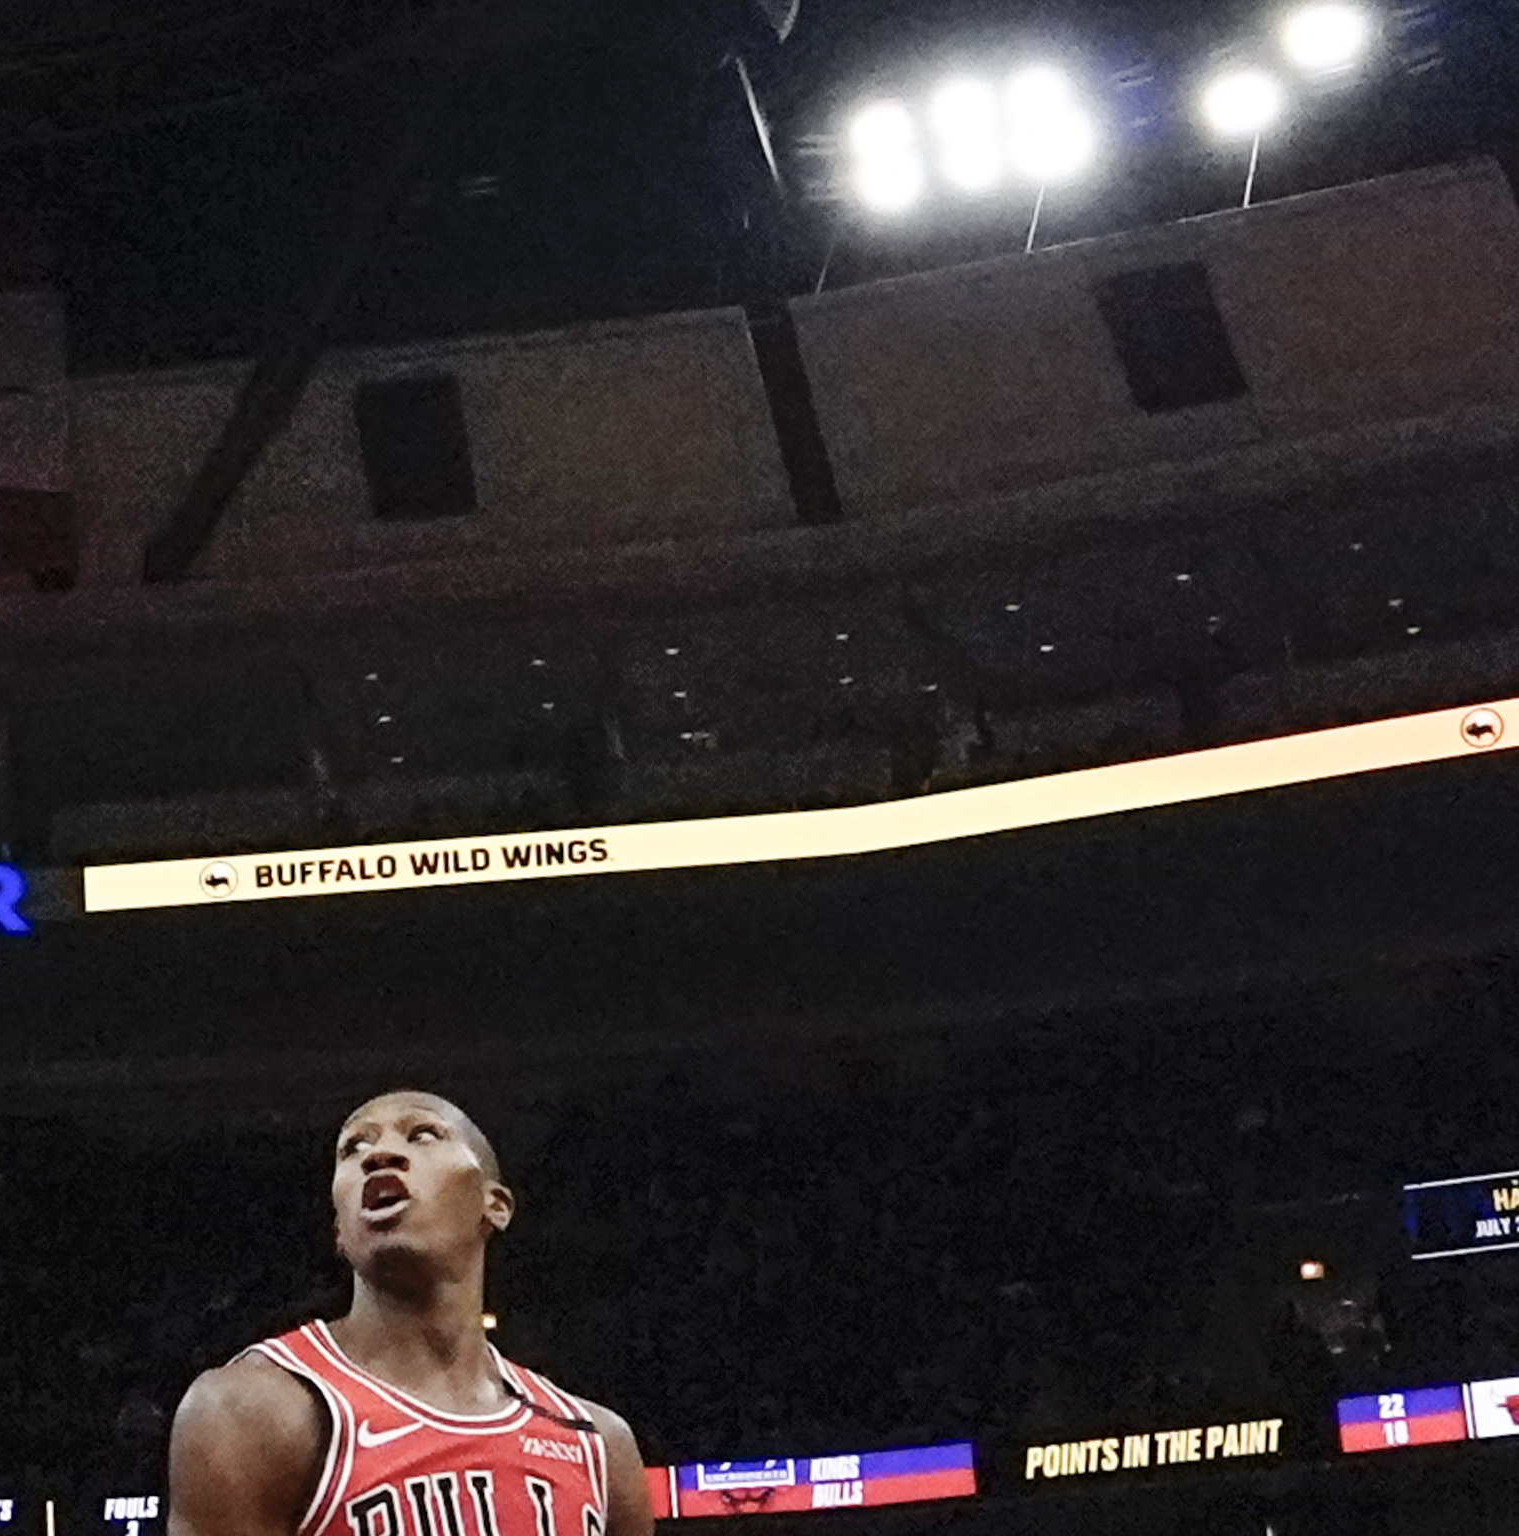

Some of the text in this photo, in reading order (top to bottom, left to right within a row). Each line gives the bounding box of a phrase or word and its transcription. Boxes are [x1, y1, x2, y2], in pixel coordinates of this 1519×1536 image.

[255, 838, 608, 888] BUFFALO WILD WINGS
[1378, 1393, 1407, 1419] 22
[1026, 1418, 1283, 1480] POINTS IN THE PAINT
[810, 1455, 861, 1482] KINGS
[812, 1481, 864, 1508] BULLS
[104, 1496, 160, 1521] FOULS
